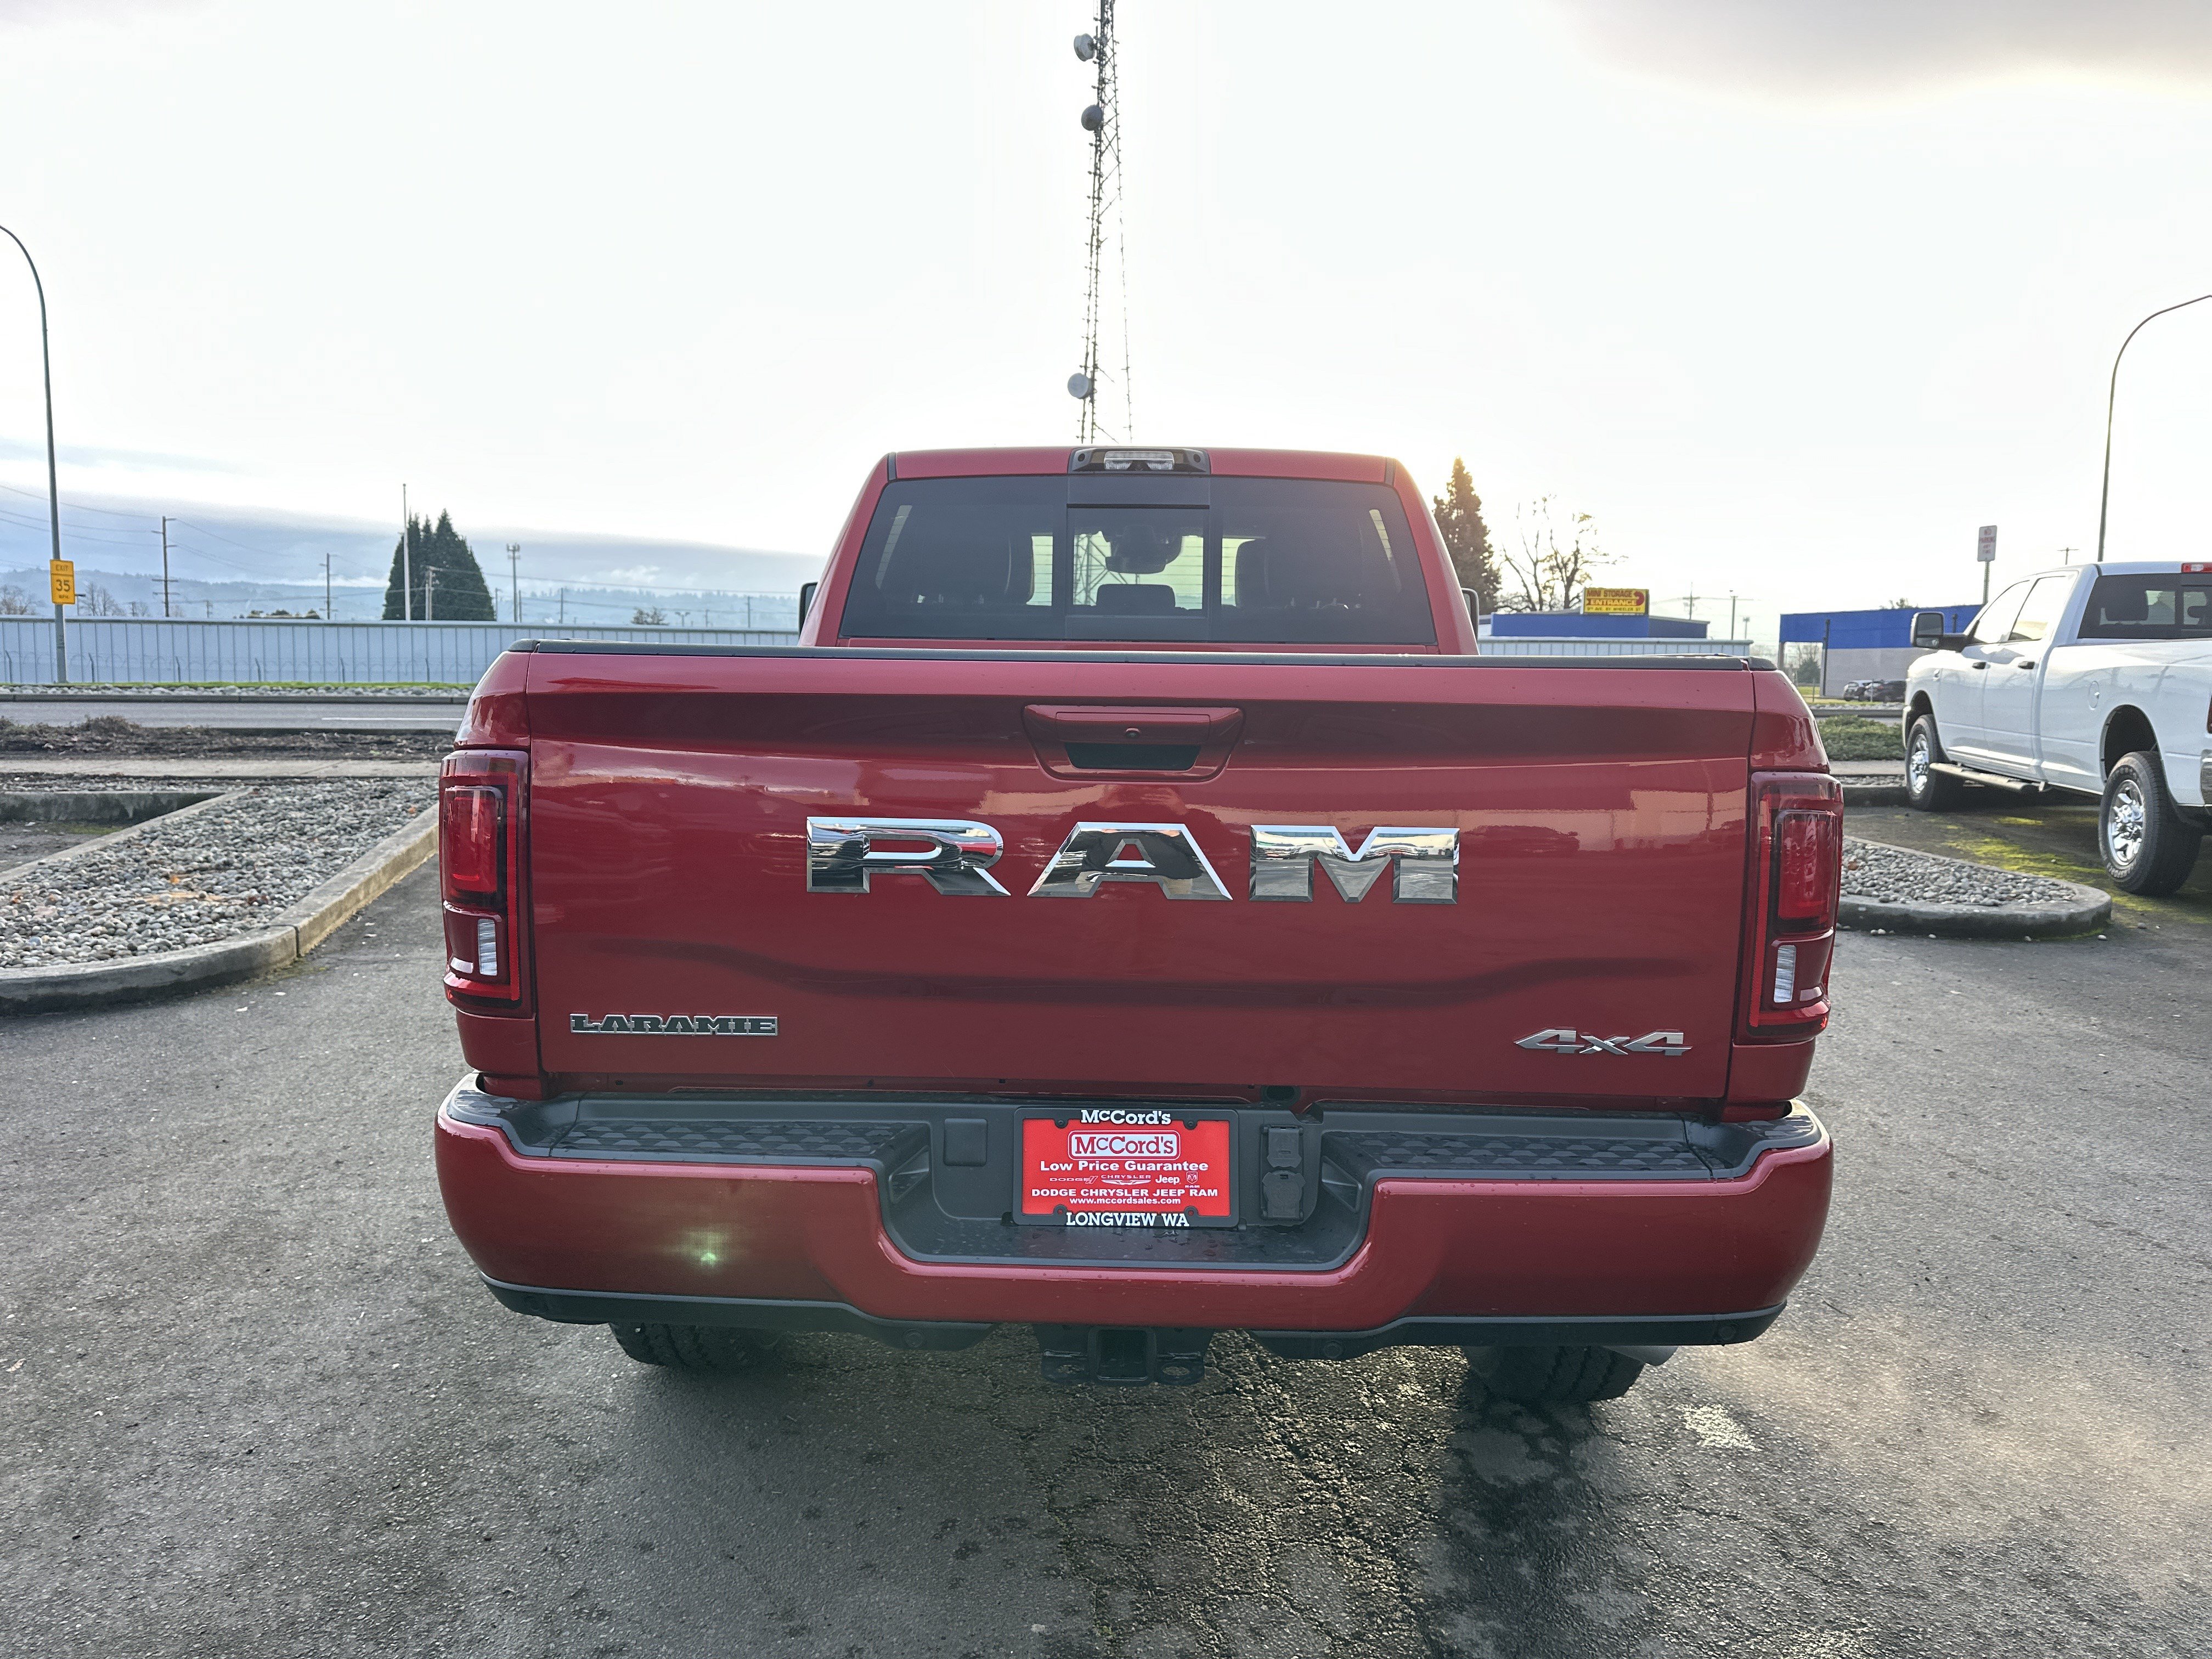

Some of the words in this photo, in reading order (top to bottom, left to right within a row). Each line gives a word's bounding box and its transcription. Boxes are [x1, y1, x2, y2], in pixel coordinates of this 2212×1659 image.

[55, 579, 70, 592] 35
[806, 816, 1460, 904] RAM
[570, 1013, 778, 1036] LARAMIE
[1081, 1109, 1171, 1125] McCord's
[1075, 1136, 1174, 1154] McCord's
[1040, 1160, 1073, 1171] Low
[1078, 1160, 1120, 1171] Price
[1125, 1161, 1209, 1171] Guarantee
[1155, 1174, 1181, 1185] Jeep
[1032, 1188, 1077, 1197] DODGE
[1080, 1188, 1149, 1197] CHRYSLER
[1066, 1212, 1157, 1226] LONGVIEW
[1161, 1213, 1189, 1227] WA
